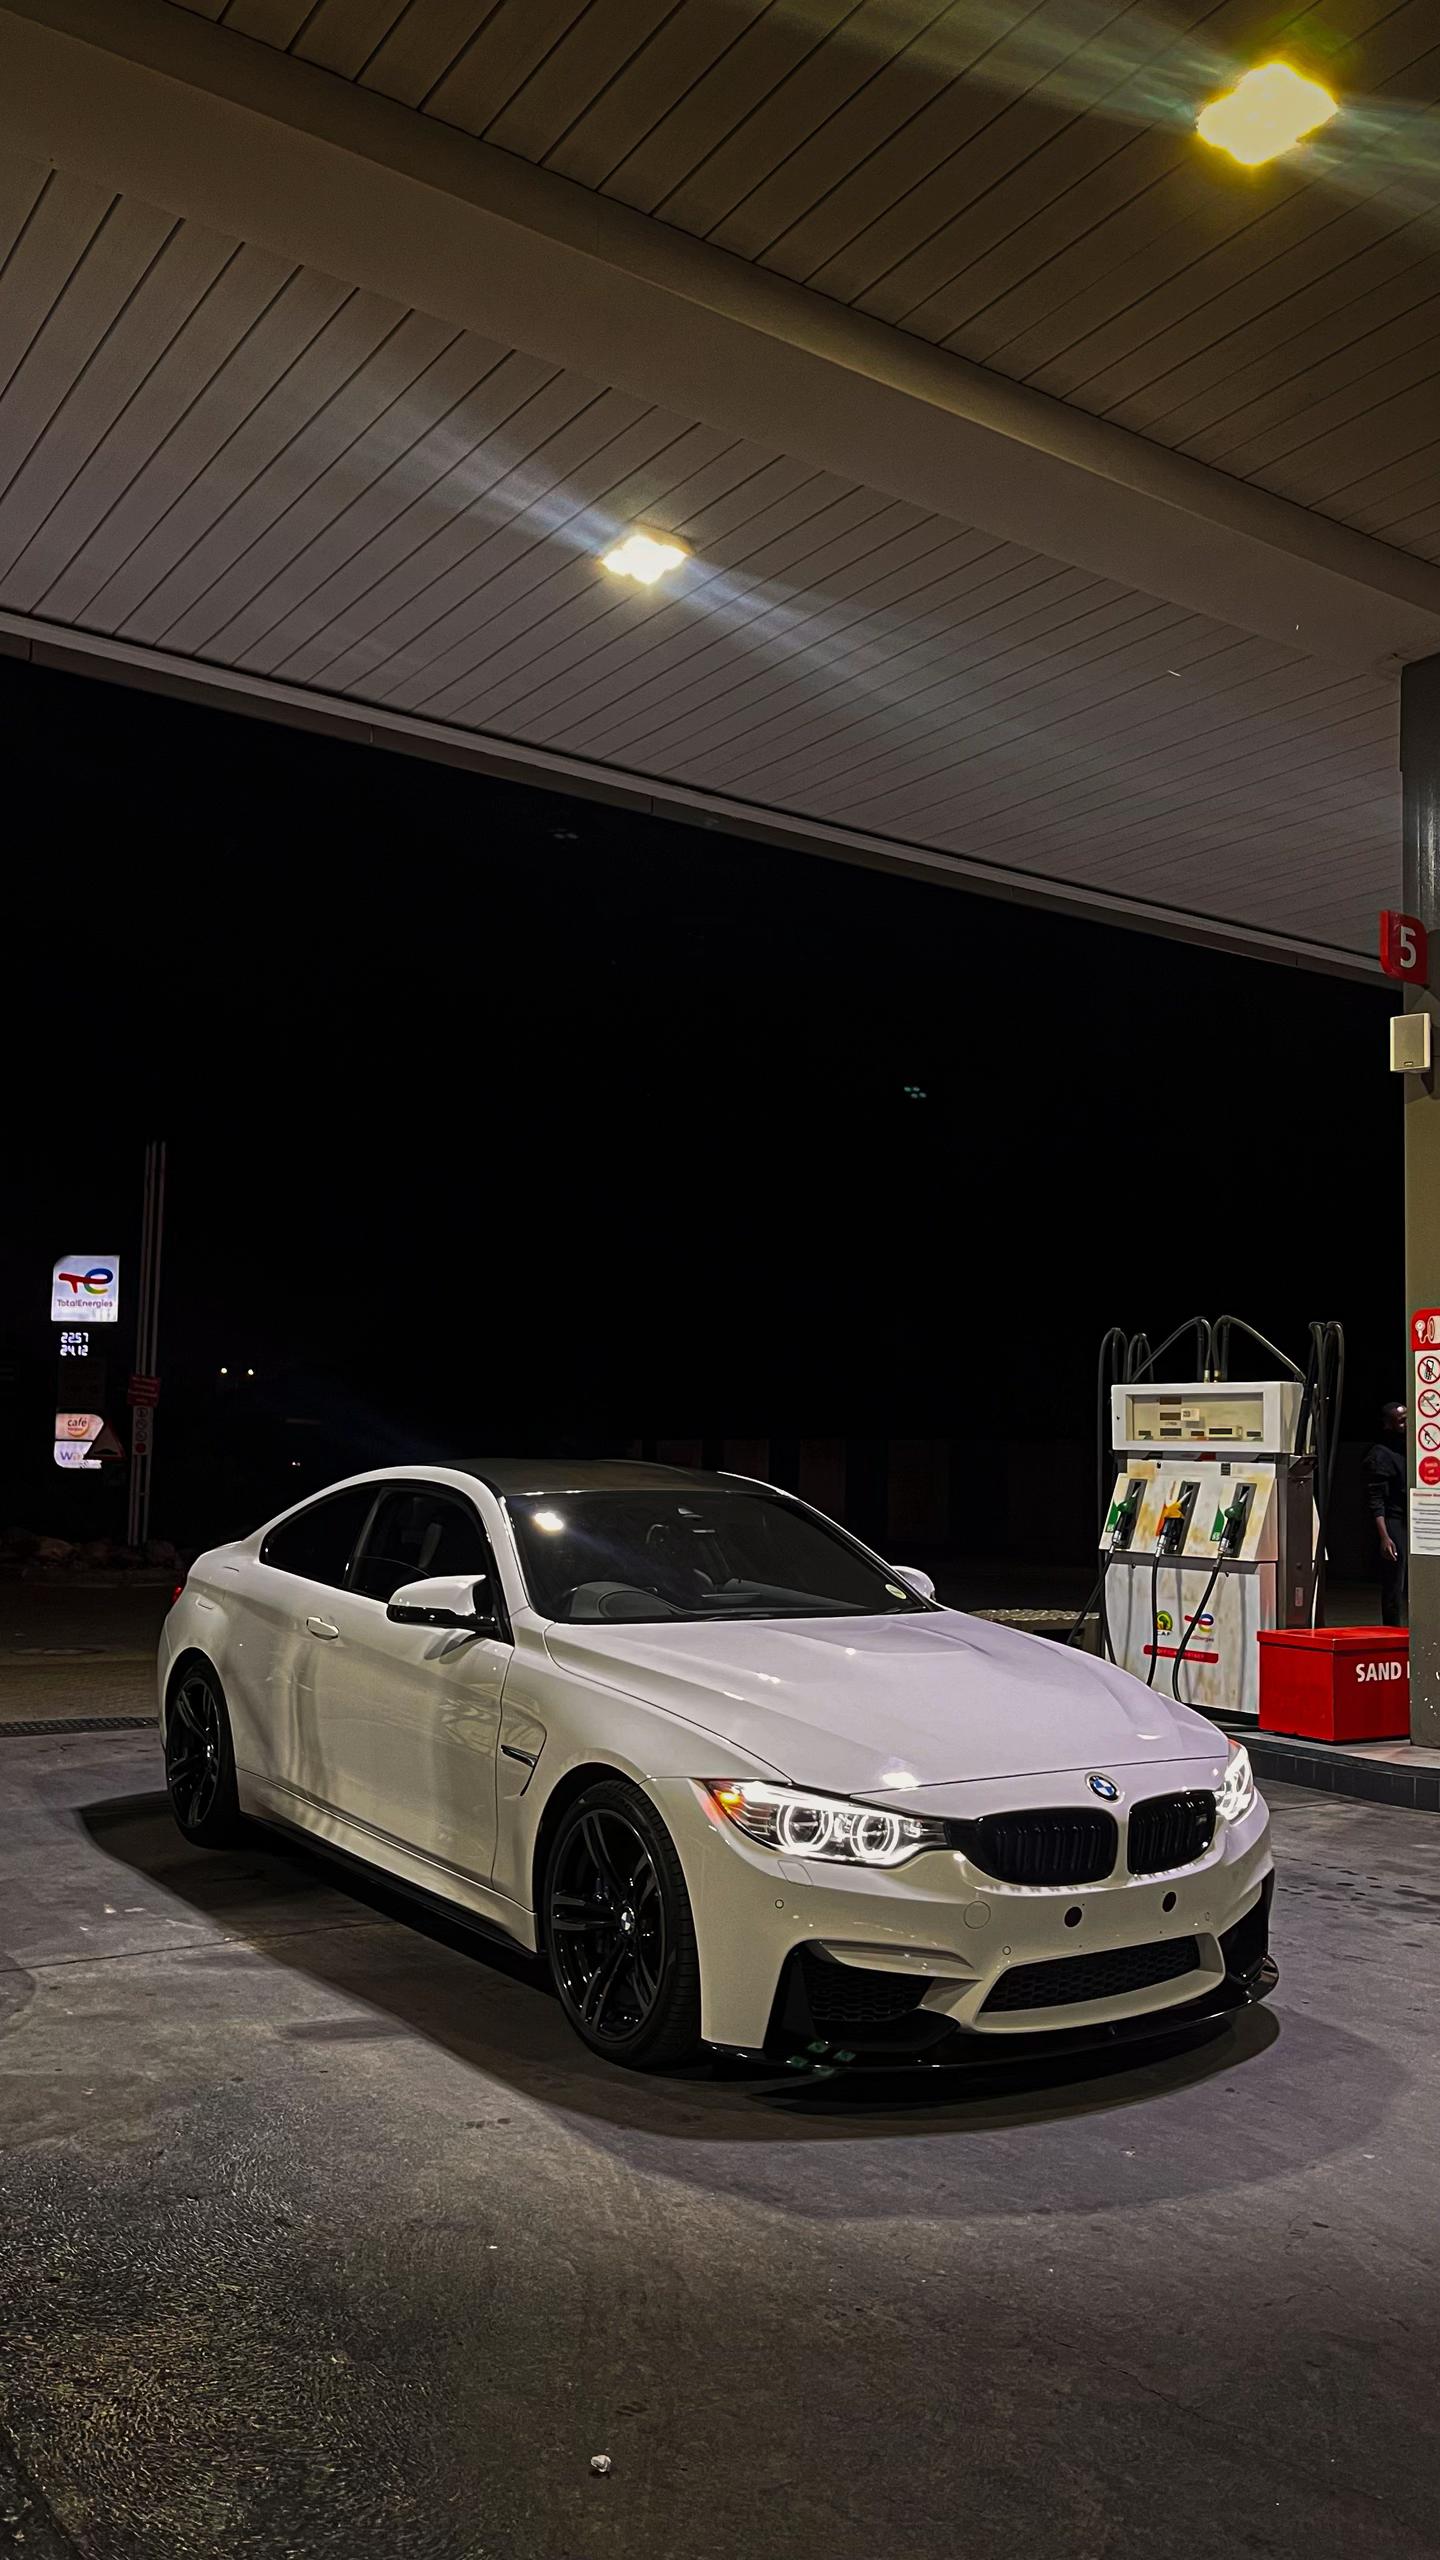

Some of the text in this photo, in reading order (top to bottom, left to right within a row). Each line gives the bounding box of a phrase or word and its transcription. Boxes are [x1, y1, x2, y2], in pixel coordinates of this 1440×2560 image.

[1400, 926, 1417, 968] 5
[57, 1299, 113, 1309] TotalEnergies
[1356, 1661, 1401, 1682] SAND
